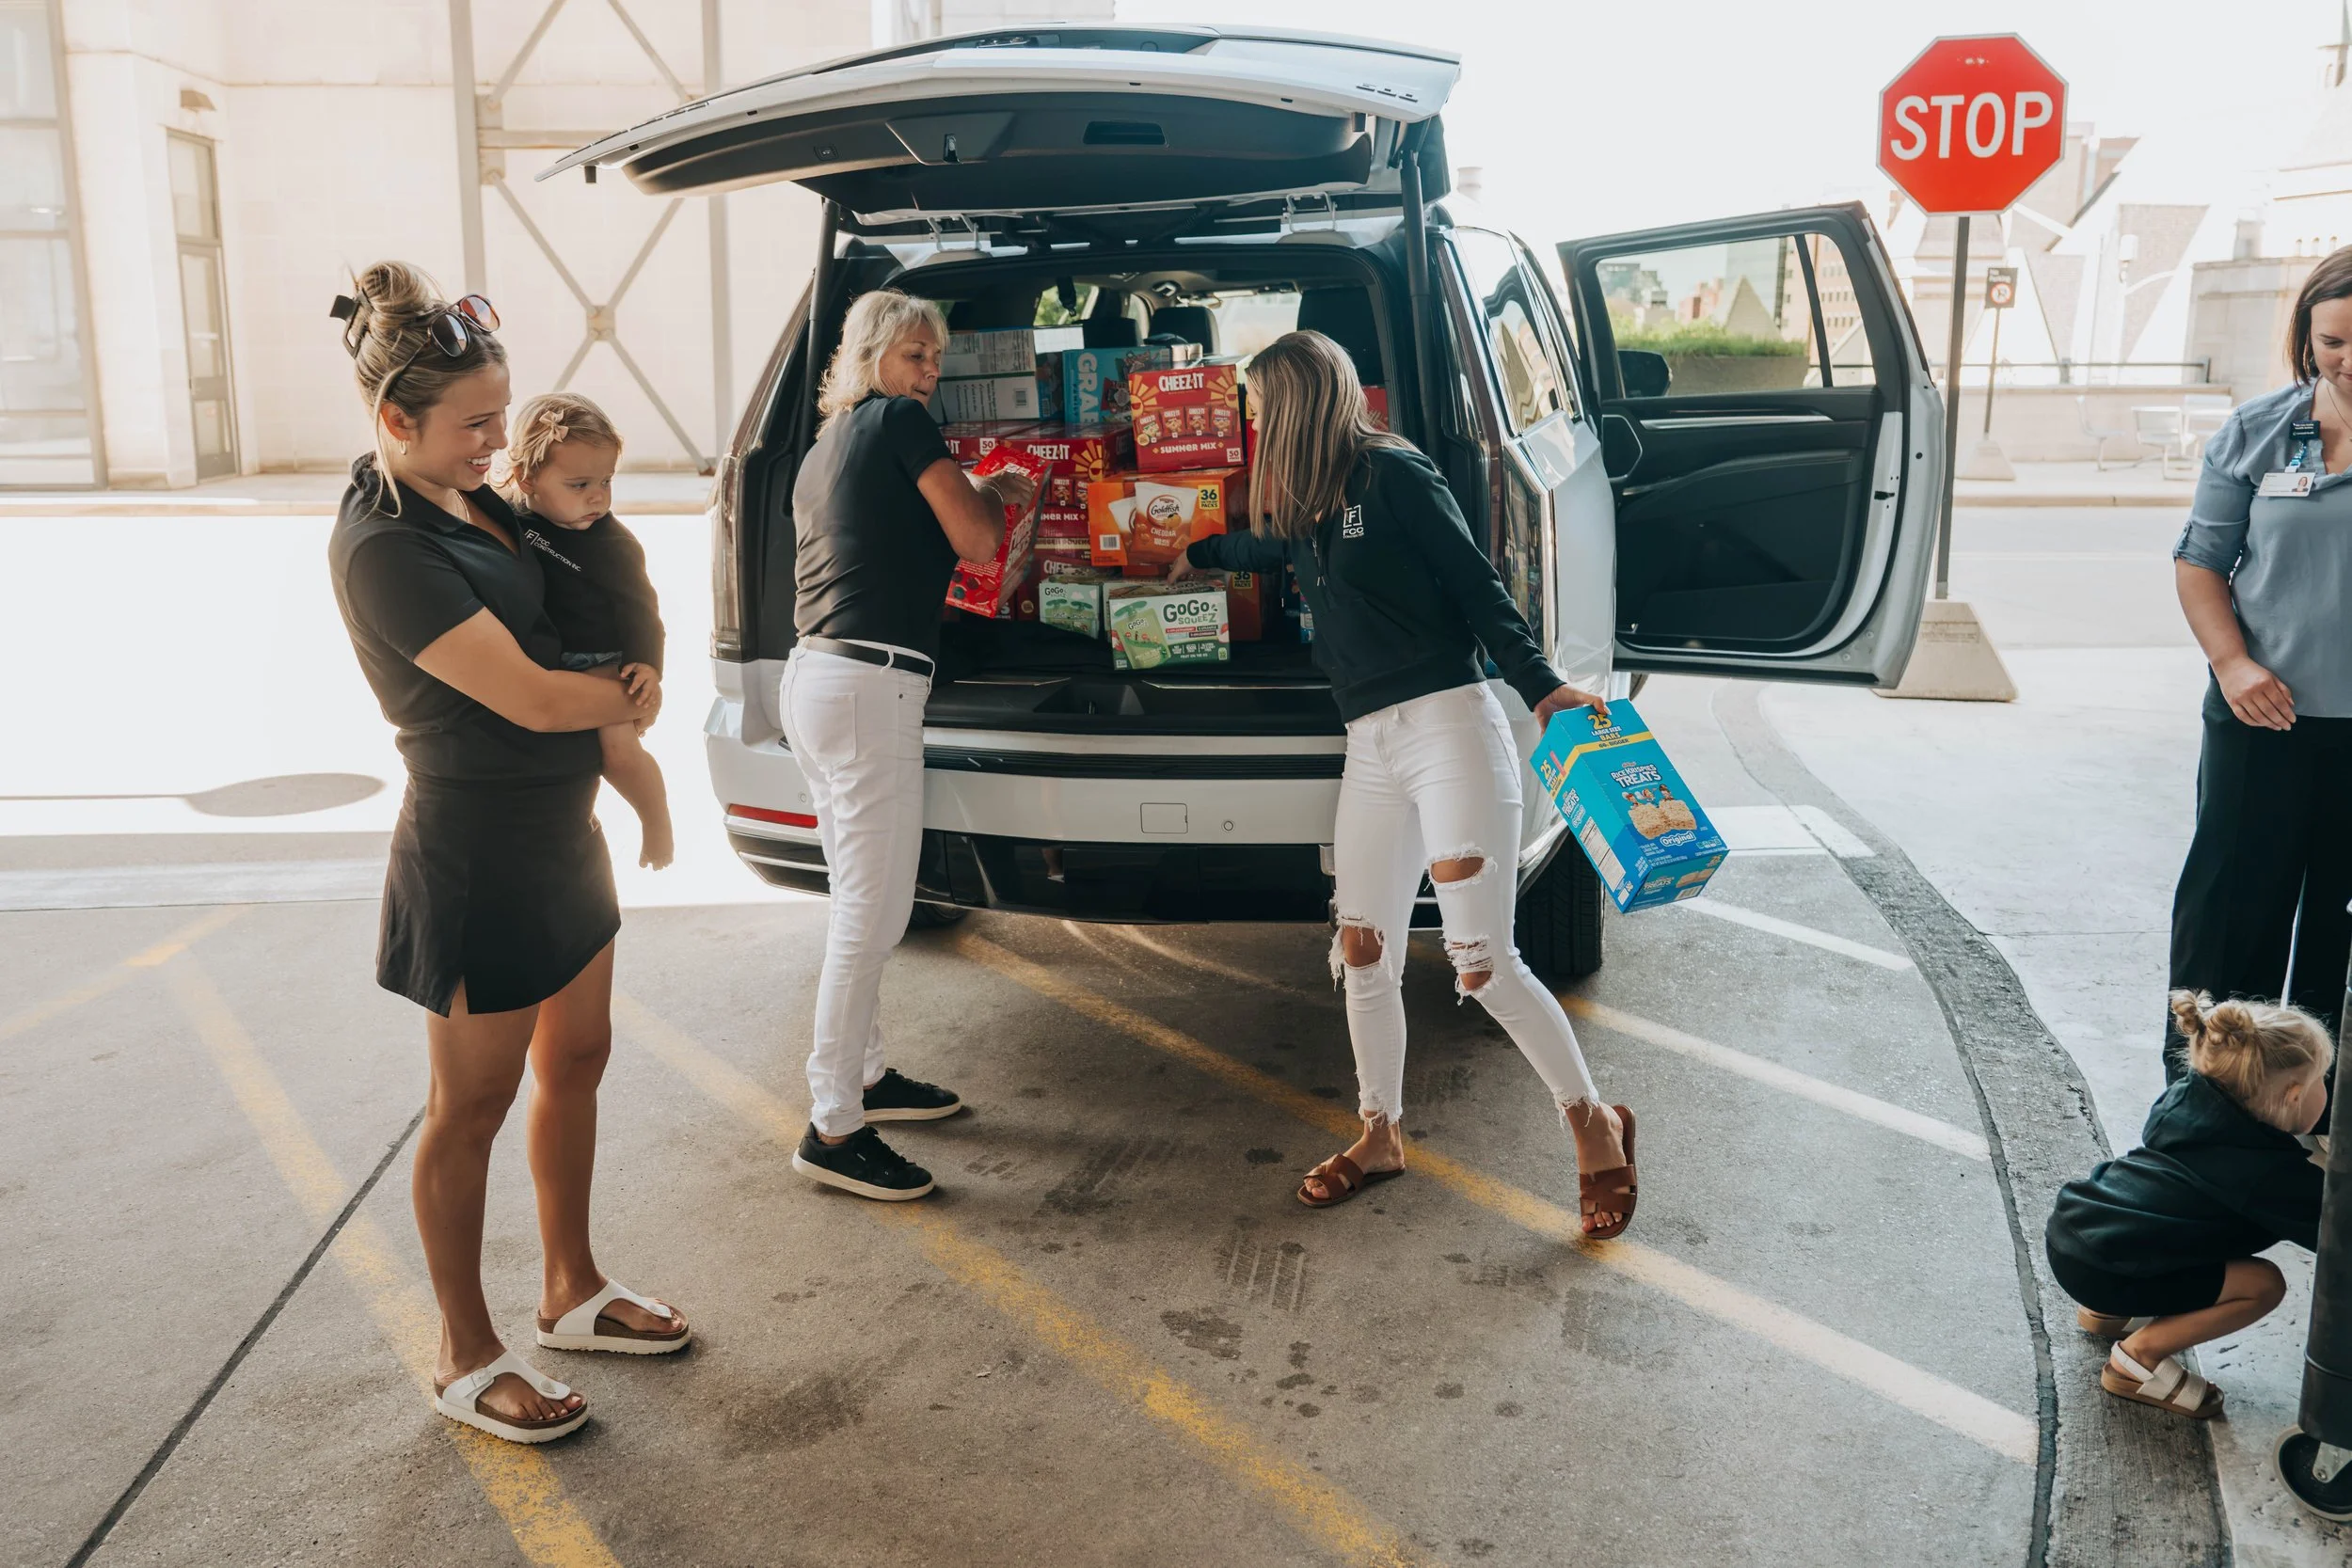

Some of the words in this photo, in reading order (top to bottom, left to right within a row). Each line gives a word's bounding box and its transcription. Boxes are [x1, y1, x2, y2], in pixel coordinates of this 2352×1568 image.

[1890, 91, 2054, 160] STOP
[982, 440, 993, 449] 50
[1200, 442, 1217, 451] MIX
[1200, 488, 1217, 500] 36
[1151, 503, 1180, 515] Goldfish
[1063, 513, 1079, 521] MIX
[534, 542, 572, 566] CONSTRUCTION
[1234, 571, 1251, 580] 36
[1163, 599, 1210, 623] GoGo
[1587, 714, 1613, 730] 25
[1591, 728, 1610, 736] LARGE
[1599, 732, 1621, 741] BARS
[1611, 769, 1627, 780] RICE
[1625, 764, 1658, 775] KRISPIES
[1615, 770, 1662, 788] TREATS
[1661, 832, 1694, 846] Original
